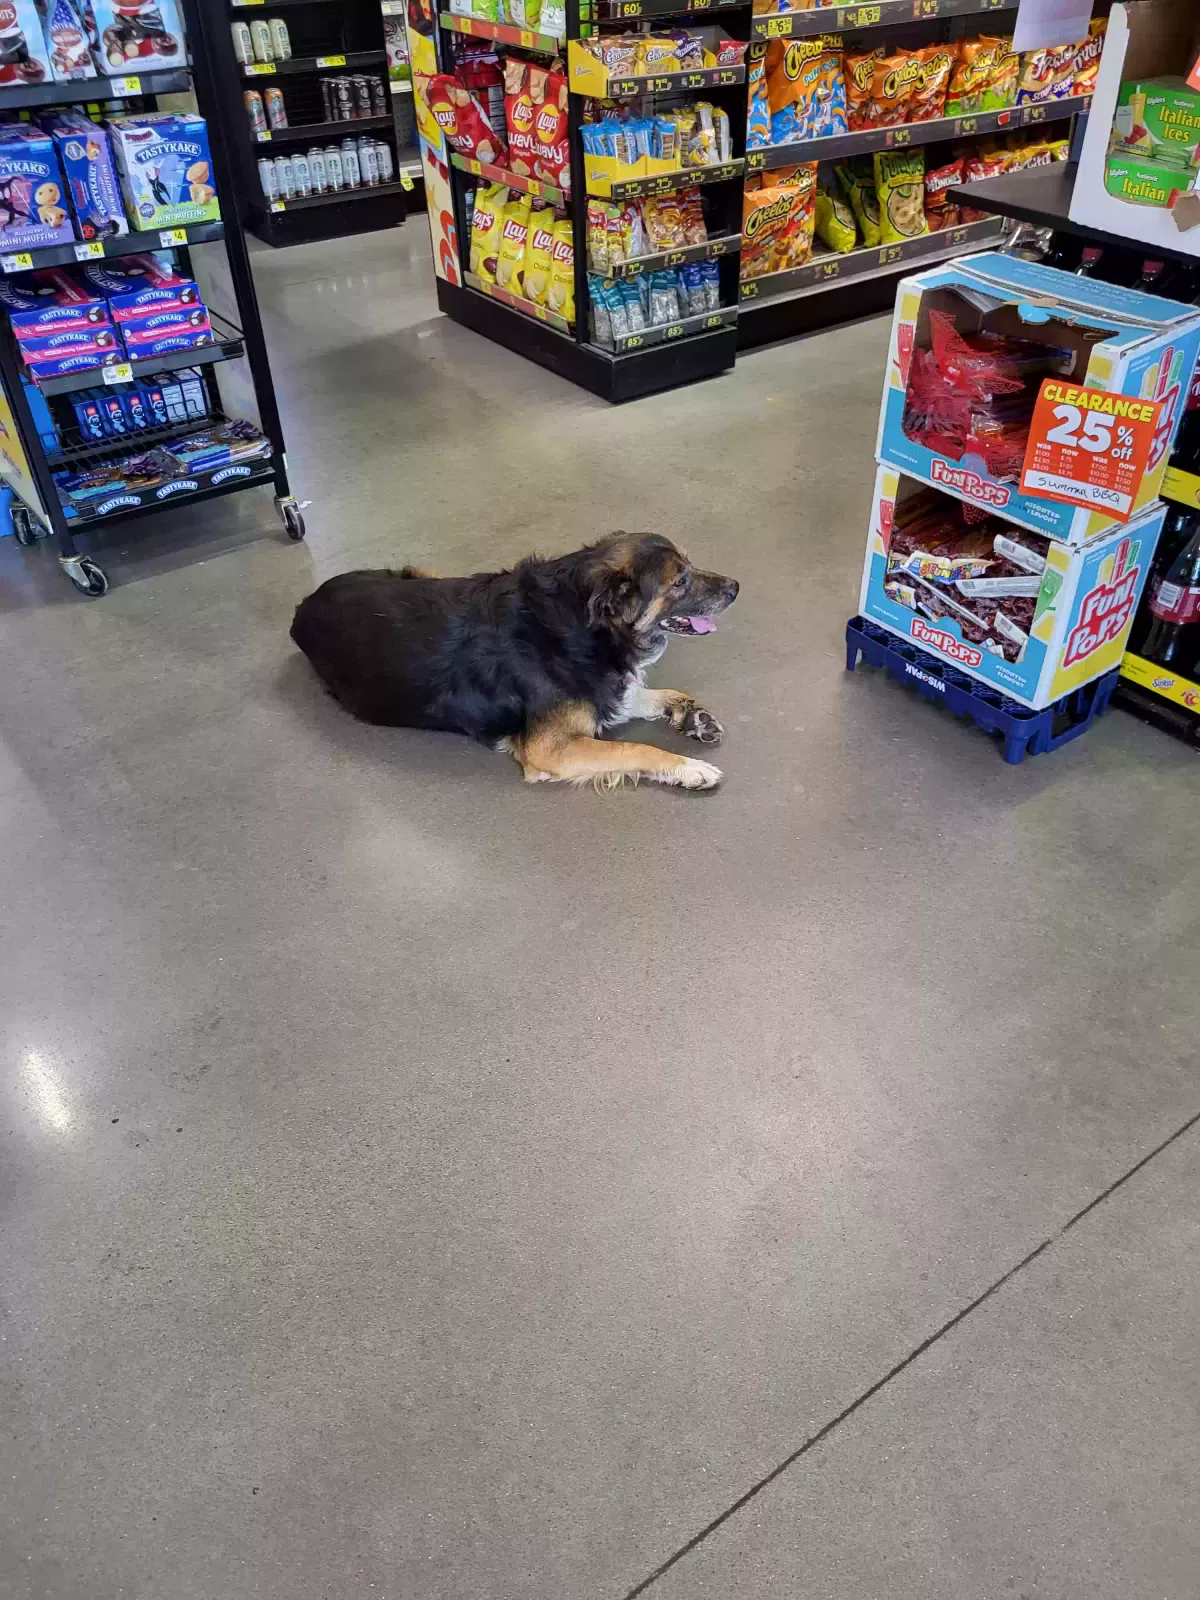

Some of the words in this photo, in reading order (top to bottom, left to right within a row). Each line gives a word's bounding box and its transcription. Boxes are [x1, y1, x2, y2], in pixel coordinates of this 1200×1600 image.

[784, 40, 824, 79] Cheeto
[1160, 105, 1200, 128] Italian
[1164, 124, 1190, 142] Ices
[138, 143, 199, 162] TASTYKAKE
[89, 163, 109, 216] TASTYKAKE
[1122, 178, 1165, 201] Italian
[175, 208, 207, 221] MUFFINS
[745, 193, 794, 239] Cheetos
[23, 232, 59, 244] MUFFINS
[174, 231, 183, 240] $4
[90, 243, 99, 253] $4
[18, 255, 27, 264] $4
[137, 290, 174, 304] TASTYKAKE
[42, 309, 81, 322] TASTYKAKE
[147, 313, 184, 327] TASTYKAKE
[49, 333, 89, 346] TASTYKAKE
[60, 357, 98, 370] TASTYKAKE
[1043, 384, 1154, 422] CLEARANCE
[1046, 404, 1116, 453] 25
[1117, 426, 1134, 446] %
[1037, 442, 1051, 451] was
[1062, 448, 1079, 457] now
[1111, 448, 1133, 461] off
[1092, 455, 1108, 464] was
[1118, 462, 1136, 471] now
[212, 467, 250, 484] TASTYKAKE
[157, 481, 198, 498] TASTYKAKE
[1092, 488, 1120, 505] BBQ
[100, 496, 141, 514] TASTYKAKE
[1083, 576, 1136, 623] FUN
[1069, 602, 1130, 661] POPS
